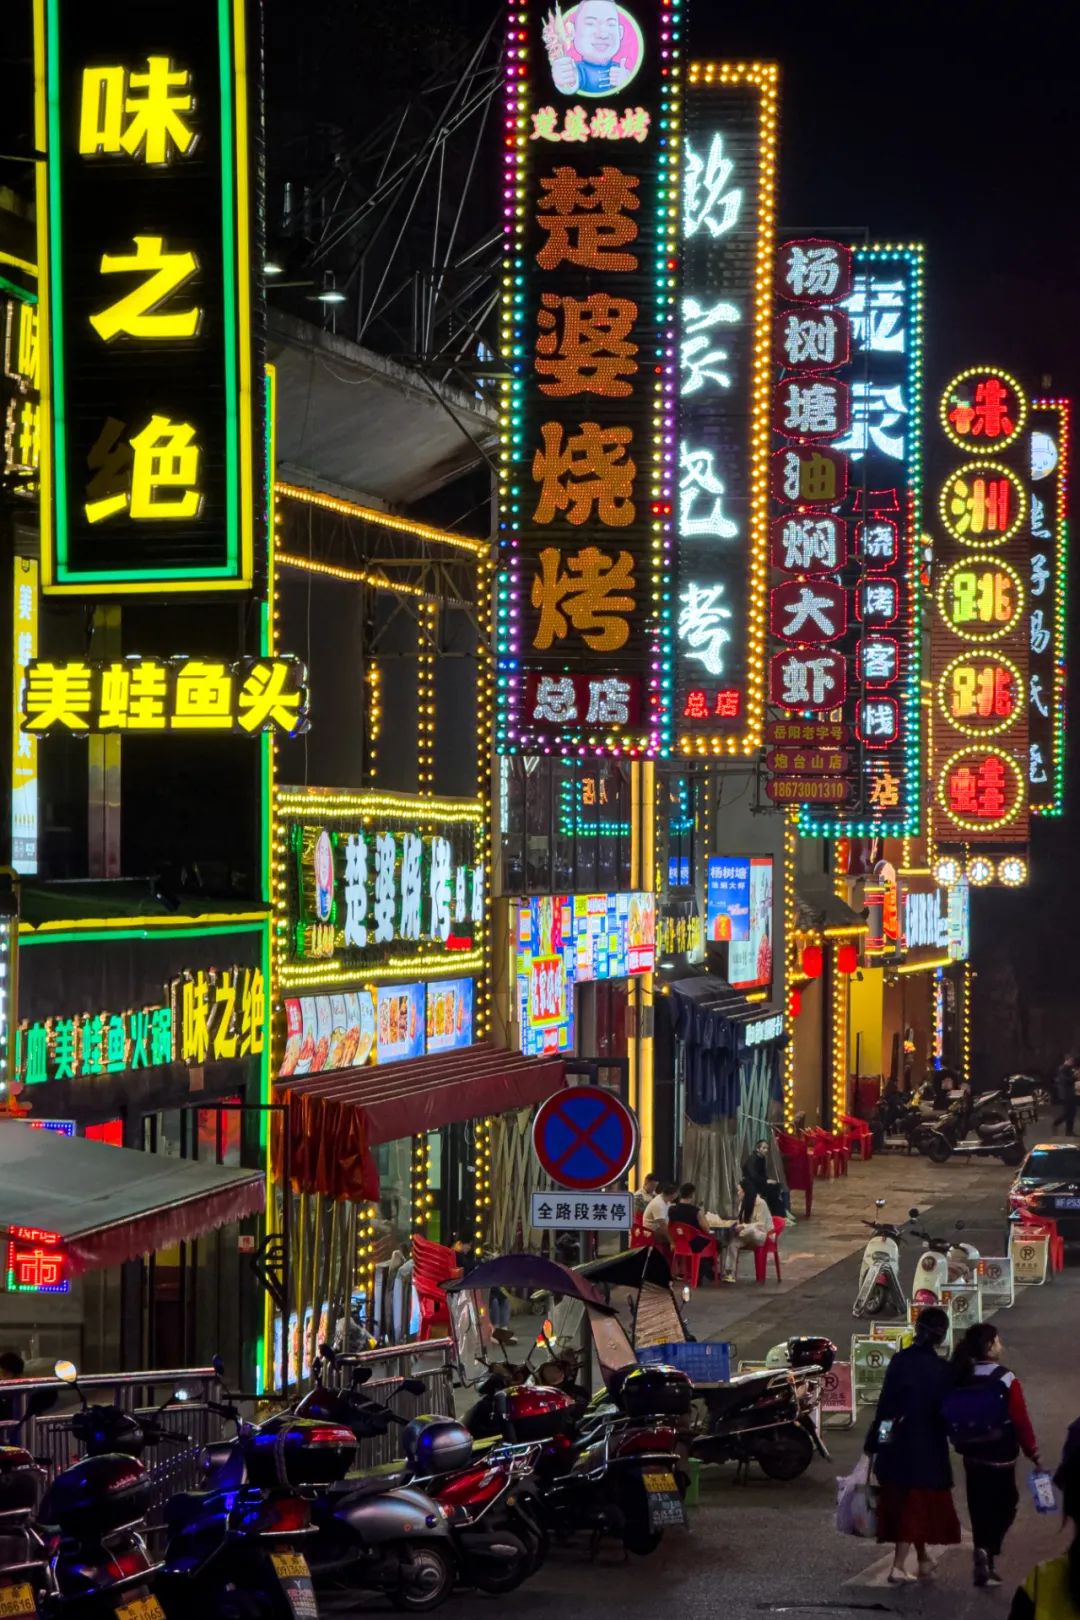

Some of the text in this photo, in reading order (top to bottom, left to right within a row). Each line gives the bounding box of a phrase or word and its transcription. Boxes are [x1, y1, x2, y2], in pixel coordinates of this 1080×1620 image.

[79, 56, 200, 524] 味之绝
[532, 165, 640, 651] 楚婆烧烤
[783, 246, 840, 704] 杨树塘油焖大虾
[949, 379, 1013, 816] 株洲跳跳蛙
[25, 661, 301, 733] 美蛙鱼头
[532, 676, 631, 725] 总店
[684, 690, 742, 719] 总店
[774, 726, 843, 740] 岳阳老字号
[773, 781, 844, 798] 18673001310
[774, 753, 843, 769] 炮台山店
[15, 1007, 171, 1085] 血美蛙鱼火锅
[182, 967, 265, 1064] 味之绝
[537, 1202, 627, 1222] 全路段禁停
